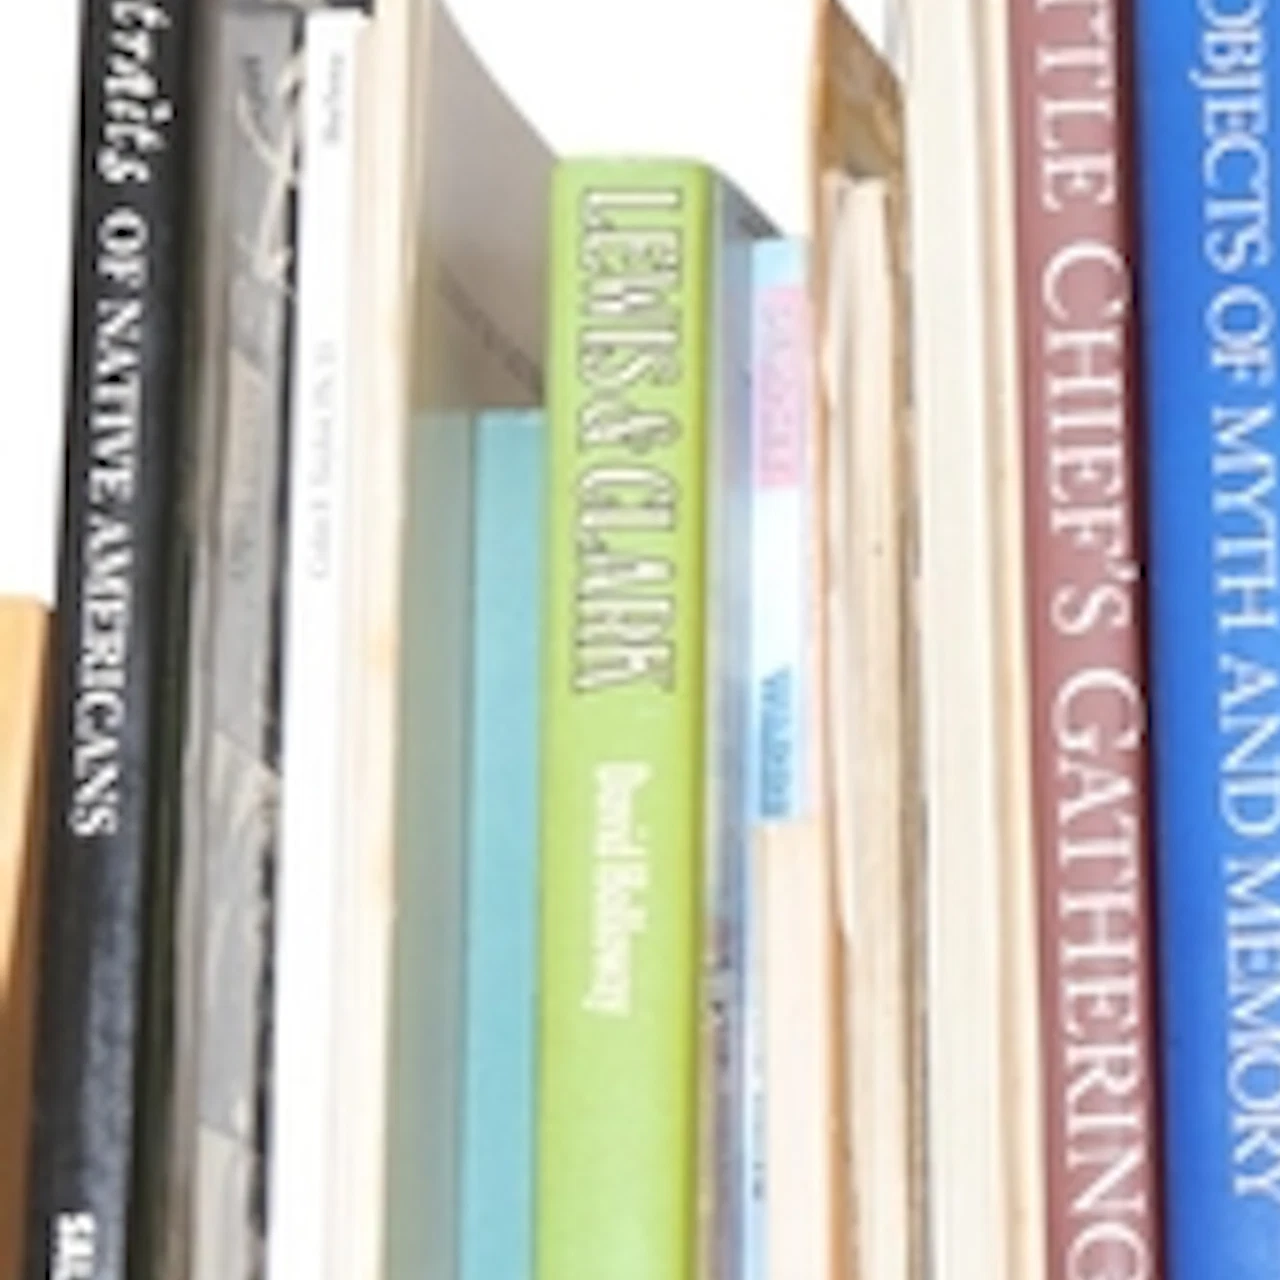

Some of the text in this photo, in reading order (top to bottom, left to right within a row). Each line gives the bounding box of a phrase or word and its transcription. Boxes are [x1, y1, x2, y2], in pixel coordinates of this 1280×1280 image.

[97, 206, 150, 289] OF
[1204, 283, 1278, 387] OF
[88, 299, 146, 502] NATIVE
[571, 186, 684, 695] LEWIS & CLARK
[1041, 238, 1139, 637] CHIEF'S
[1210, 404, 1280, 636] MYTH
[67, 518, 135, 837] AMERICANS
[582, 761, 651, 1017] David Holloway
